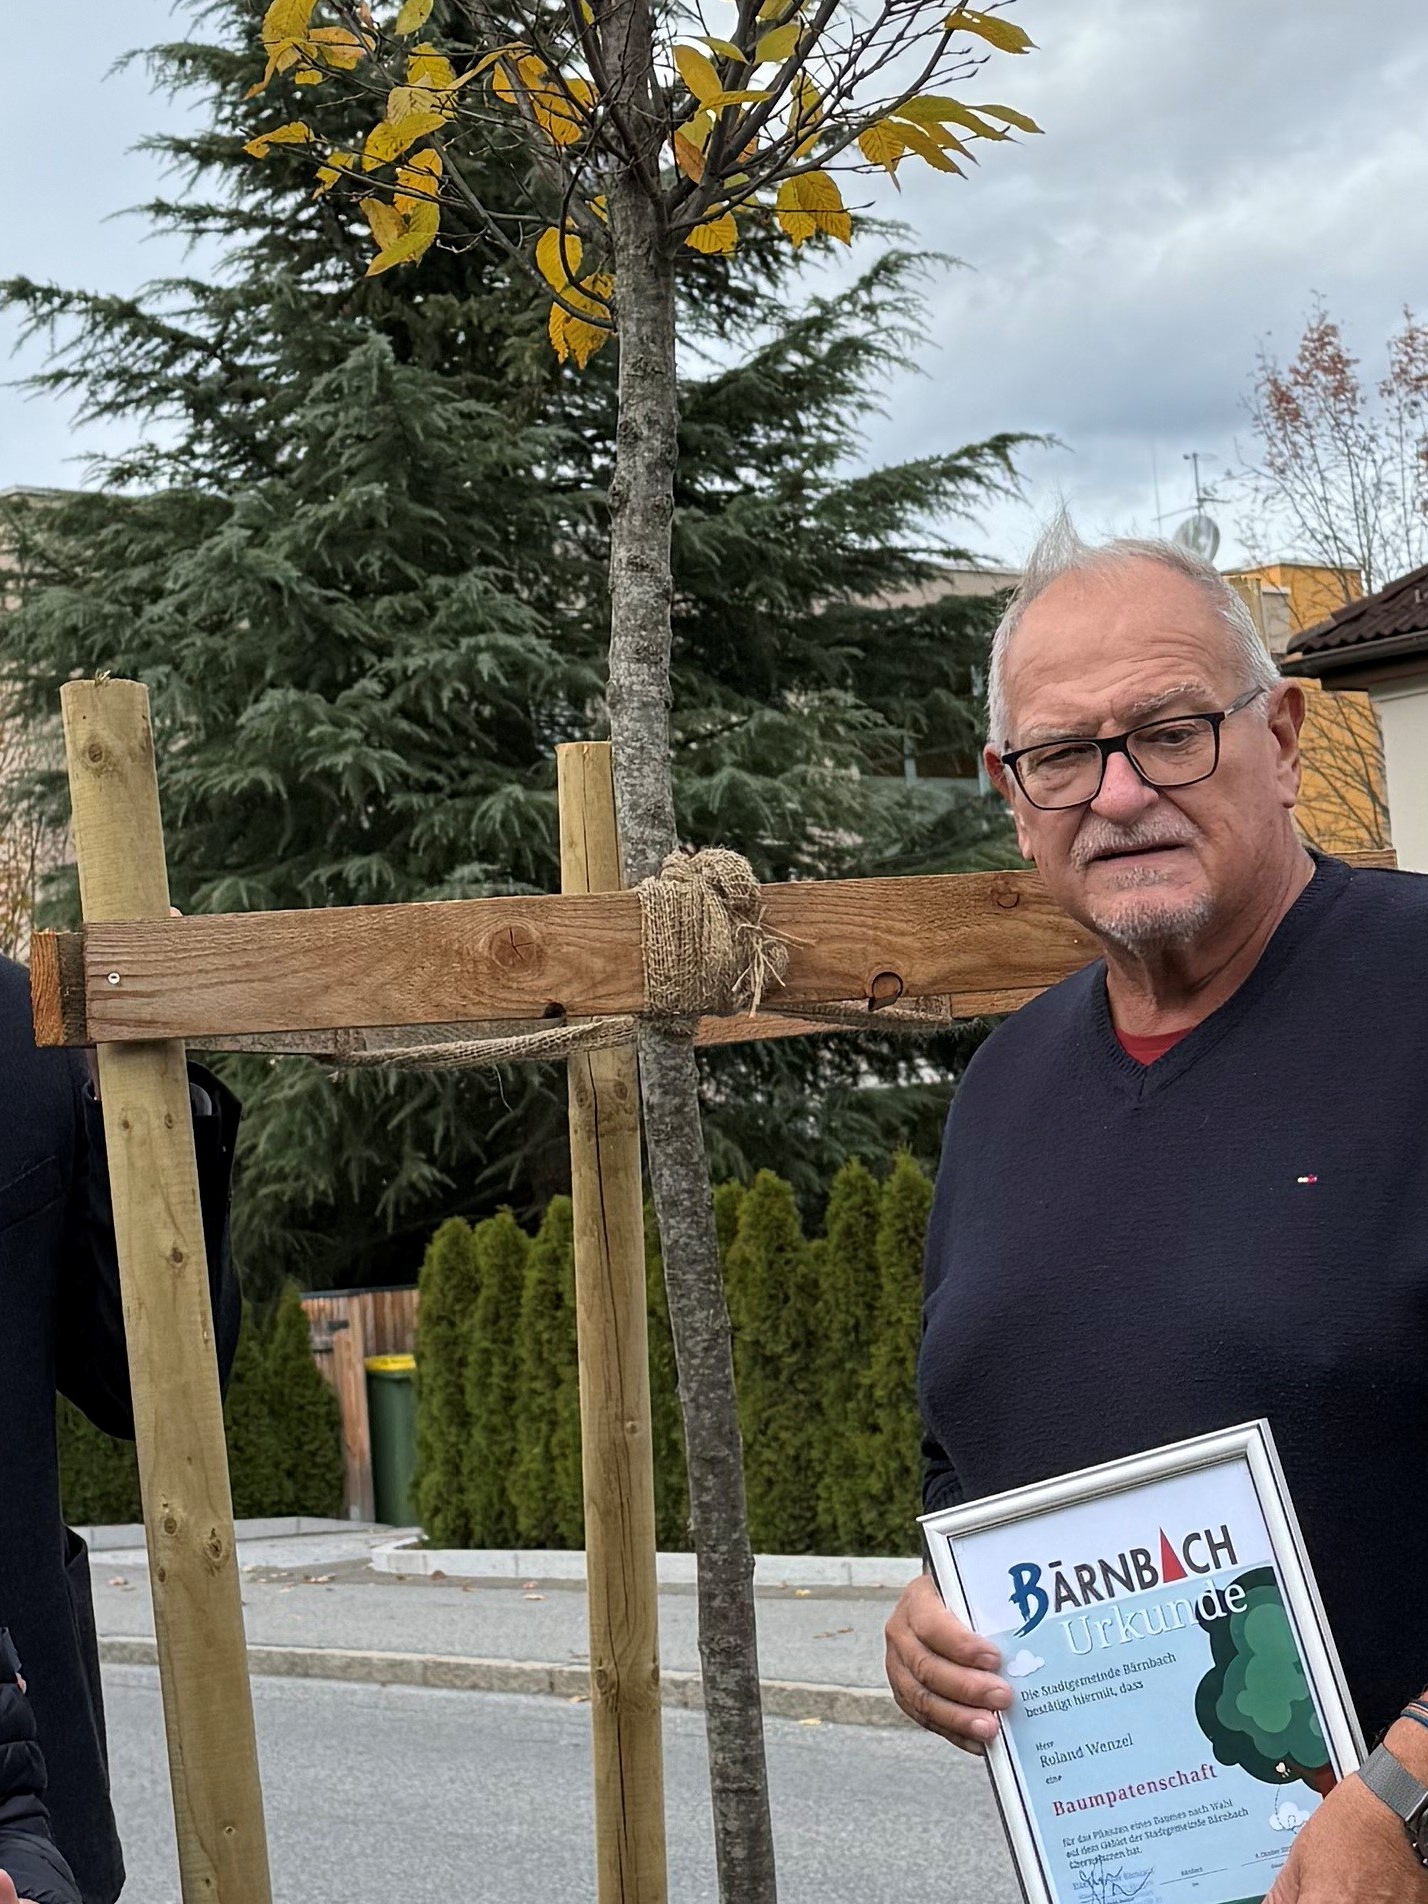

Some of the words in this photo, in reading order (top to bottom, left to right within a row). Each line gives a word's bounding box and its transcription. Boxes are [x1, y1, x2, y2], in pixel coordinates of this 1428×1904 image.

[1060, 1579, 1249, 1656] Urkunde
[1020, 1688, 1040, 1702] Die
[1041, 1668, 1121, 1697] Stadtgemeinde
[1122, 1652, 1177, 1675] Bärnbach
[1025, 1698, 1072, 1718] bestätigt
[1119, 1680, 1144, 1694] dass
[1039, 1746, 1085, 1768] Roland
[1086, 1733, 1134, 1756] Wenzel
[1053, 1763, 1218, 1816] Baumpatenschaft
